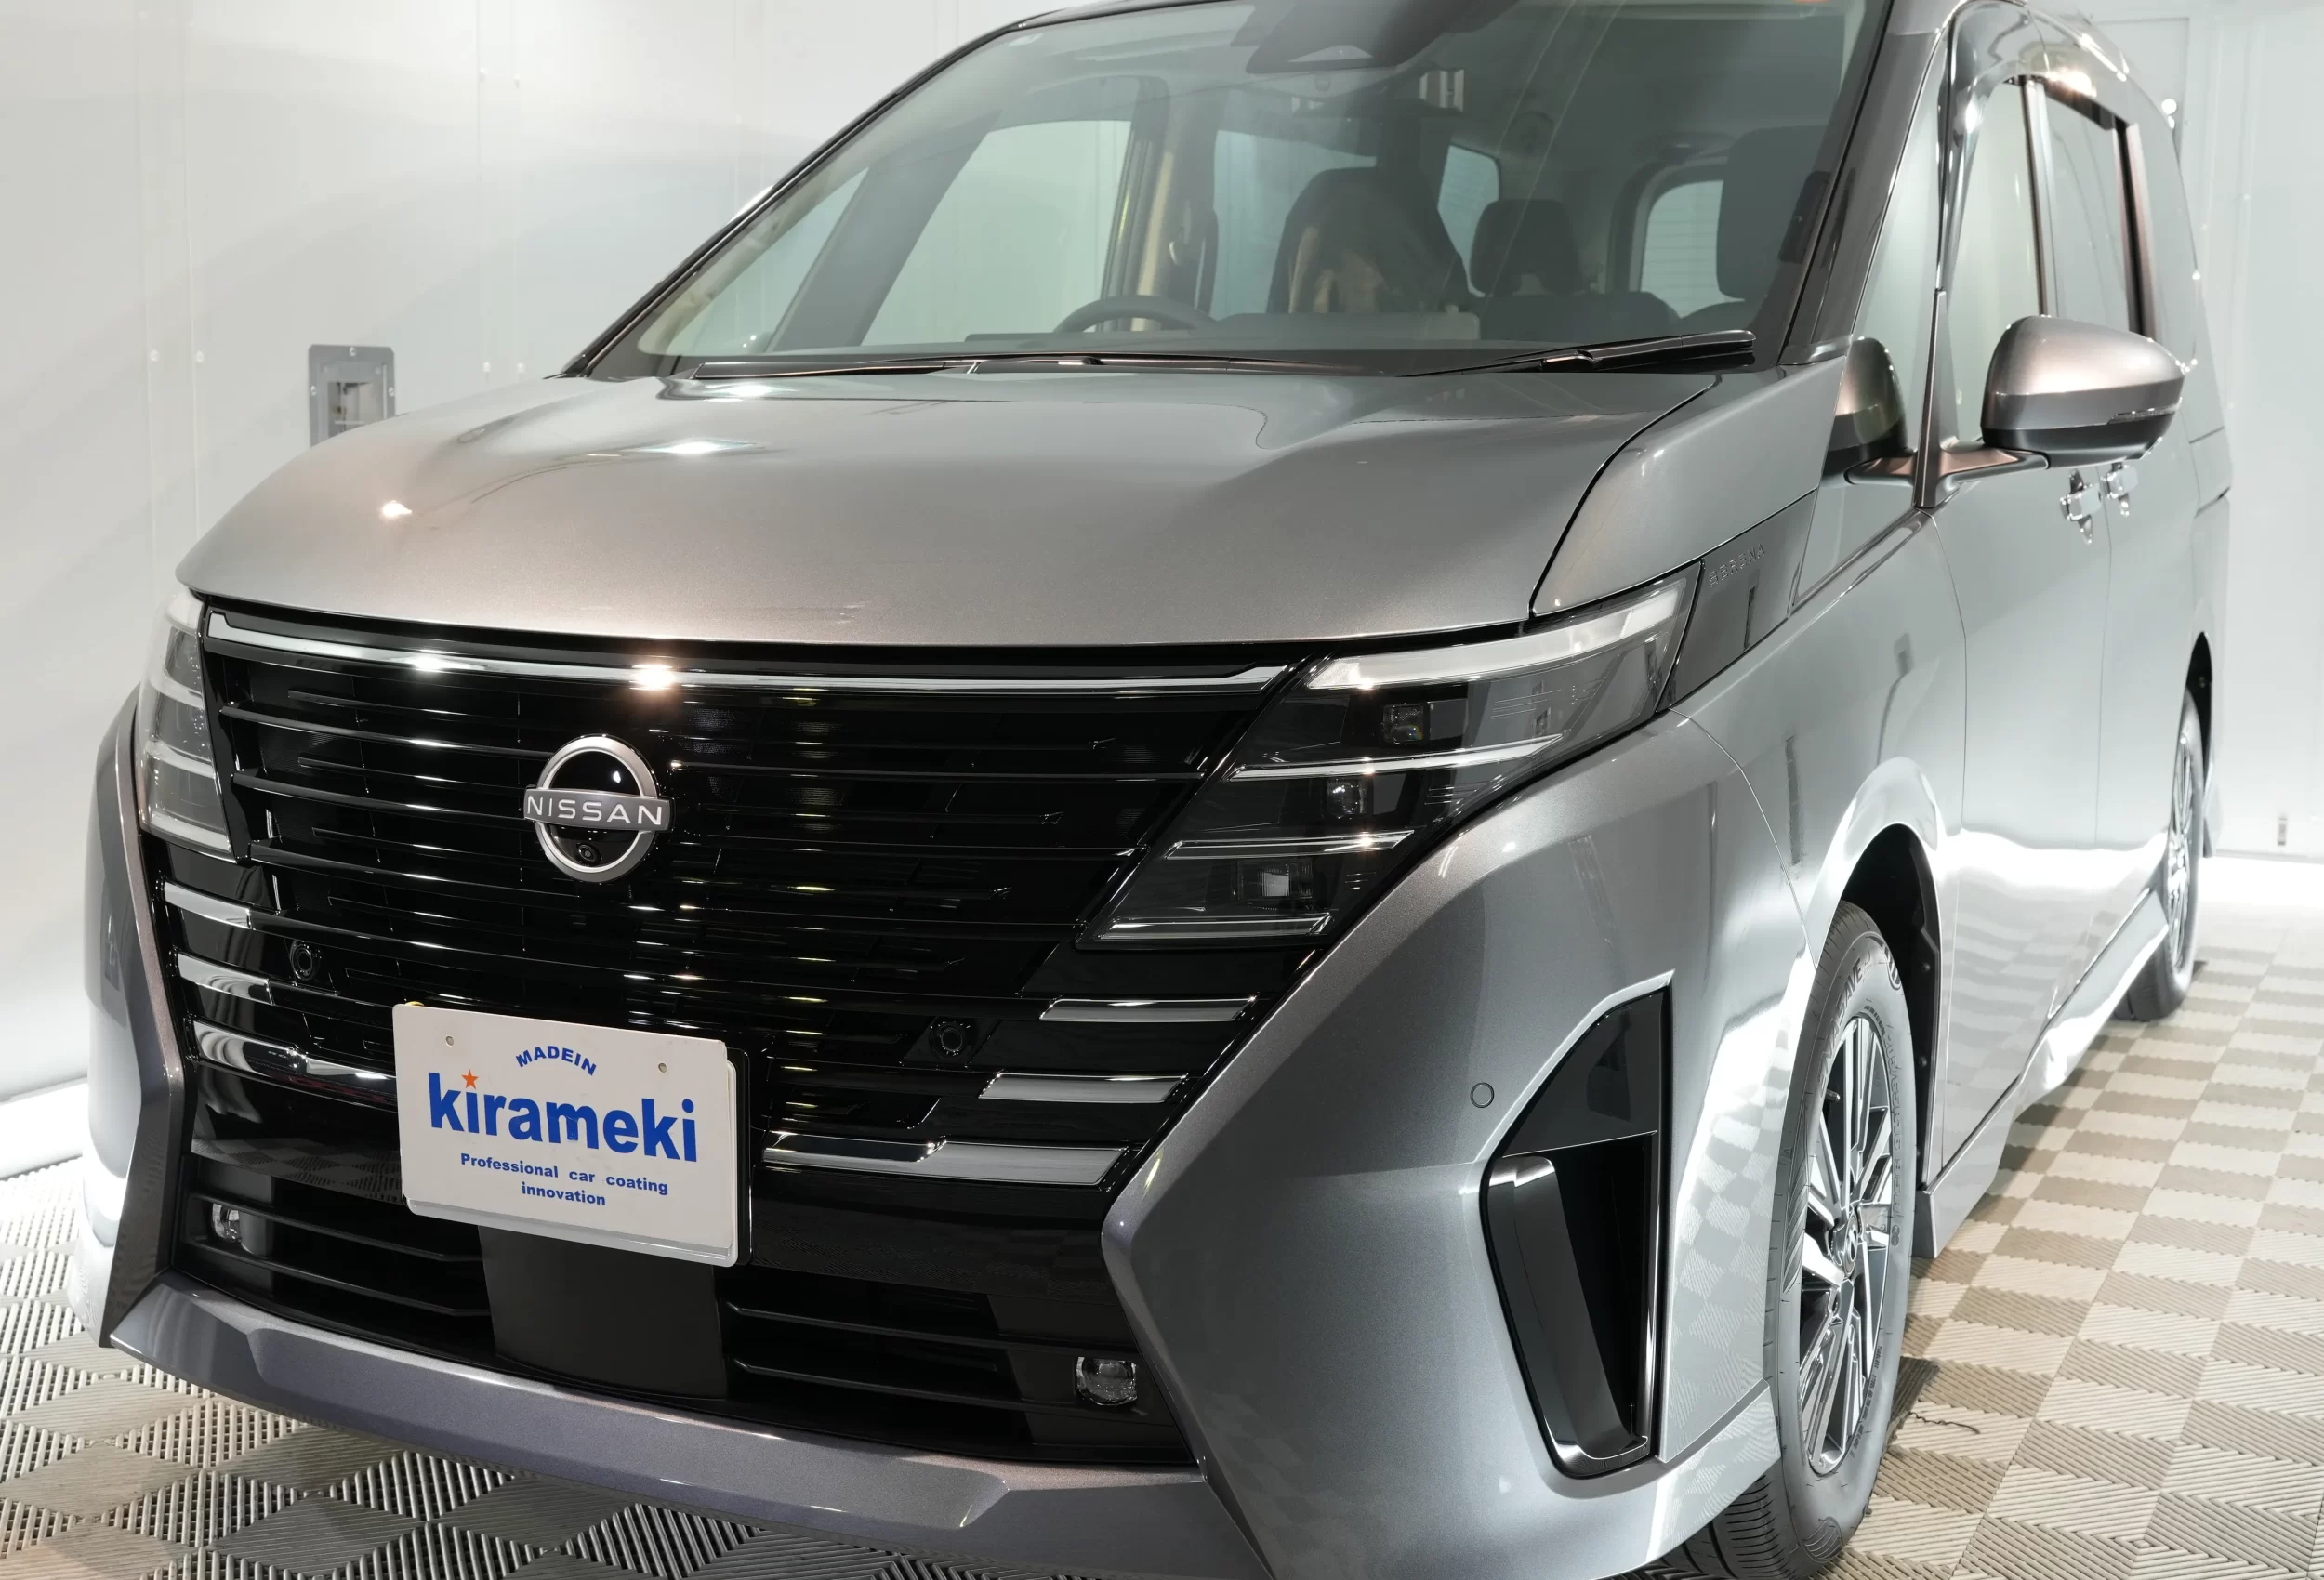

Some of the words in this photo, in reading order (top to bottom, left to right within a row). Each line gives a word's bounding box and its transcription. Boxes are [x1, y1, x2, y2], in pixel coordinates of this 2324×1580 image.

[526, 795, 663, 826] NISSAN
[428, 1069, 698, 1163] kirameki
[460, 1152, 559, 1178] Professional
[568, 1169, 596, 1183] car
[605, 1174, 669, 1196] coating
[521, 1181, 607, 1205] innovation
